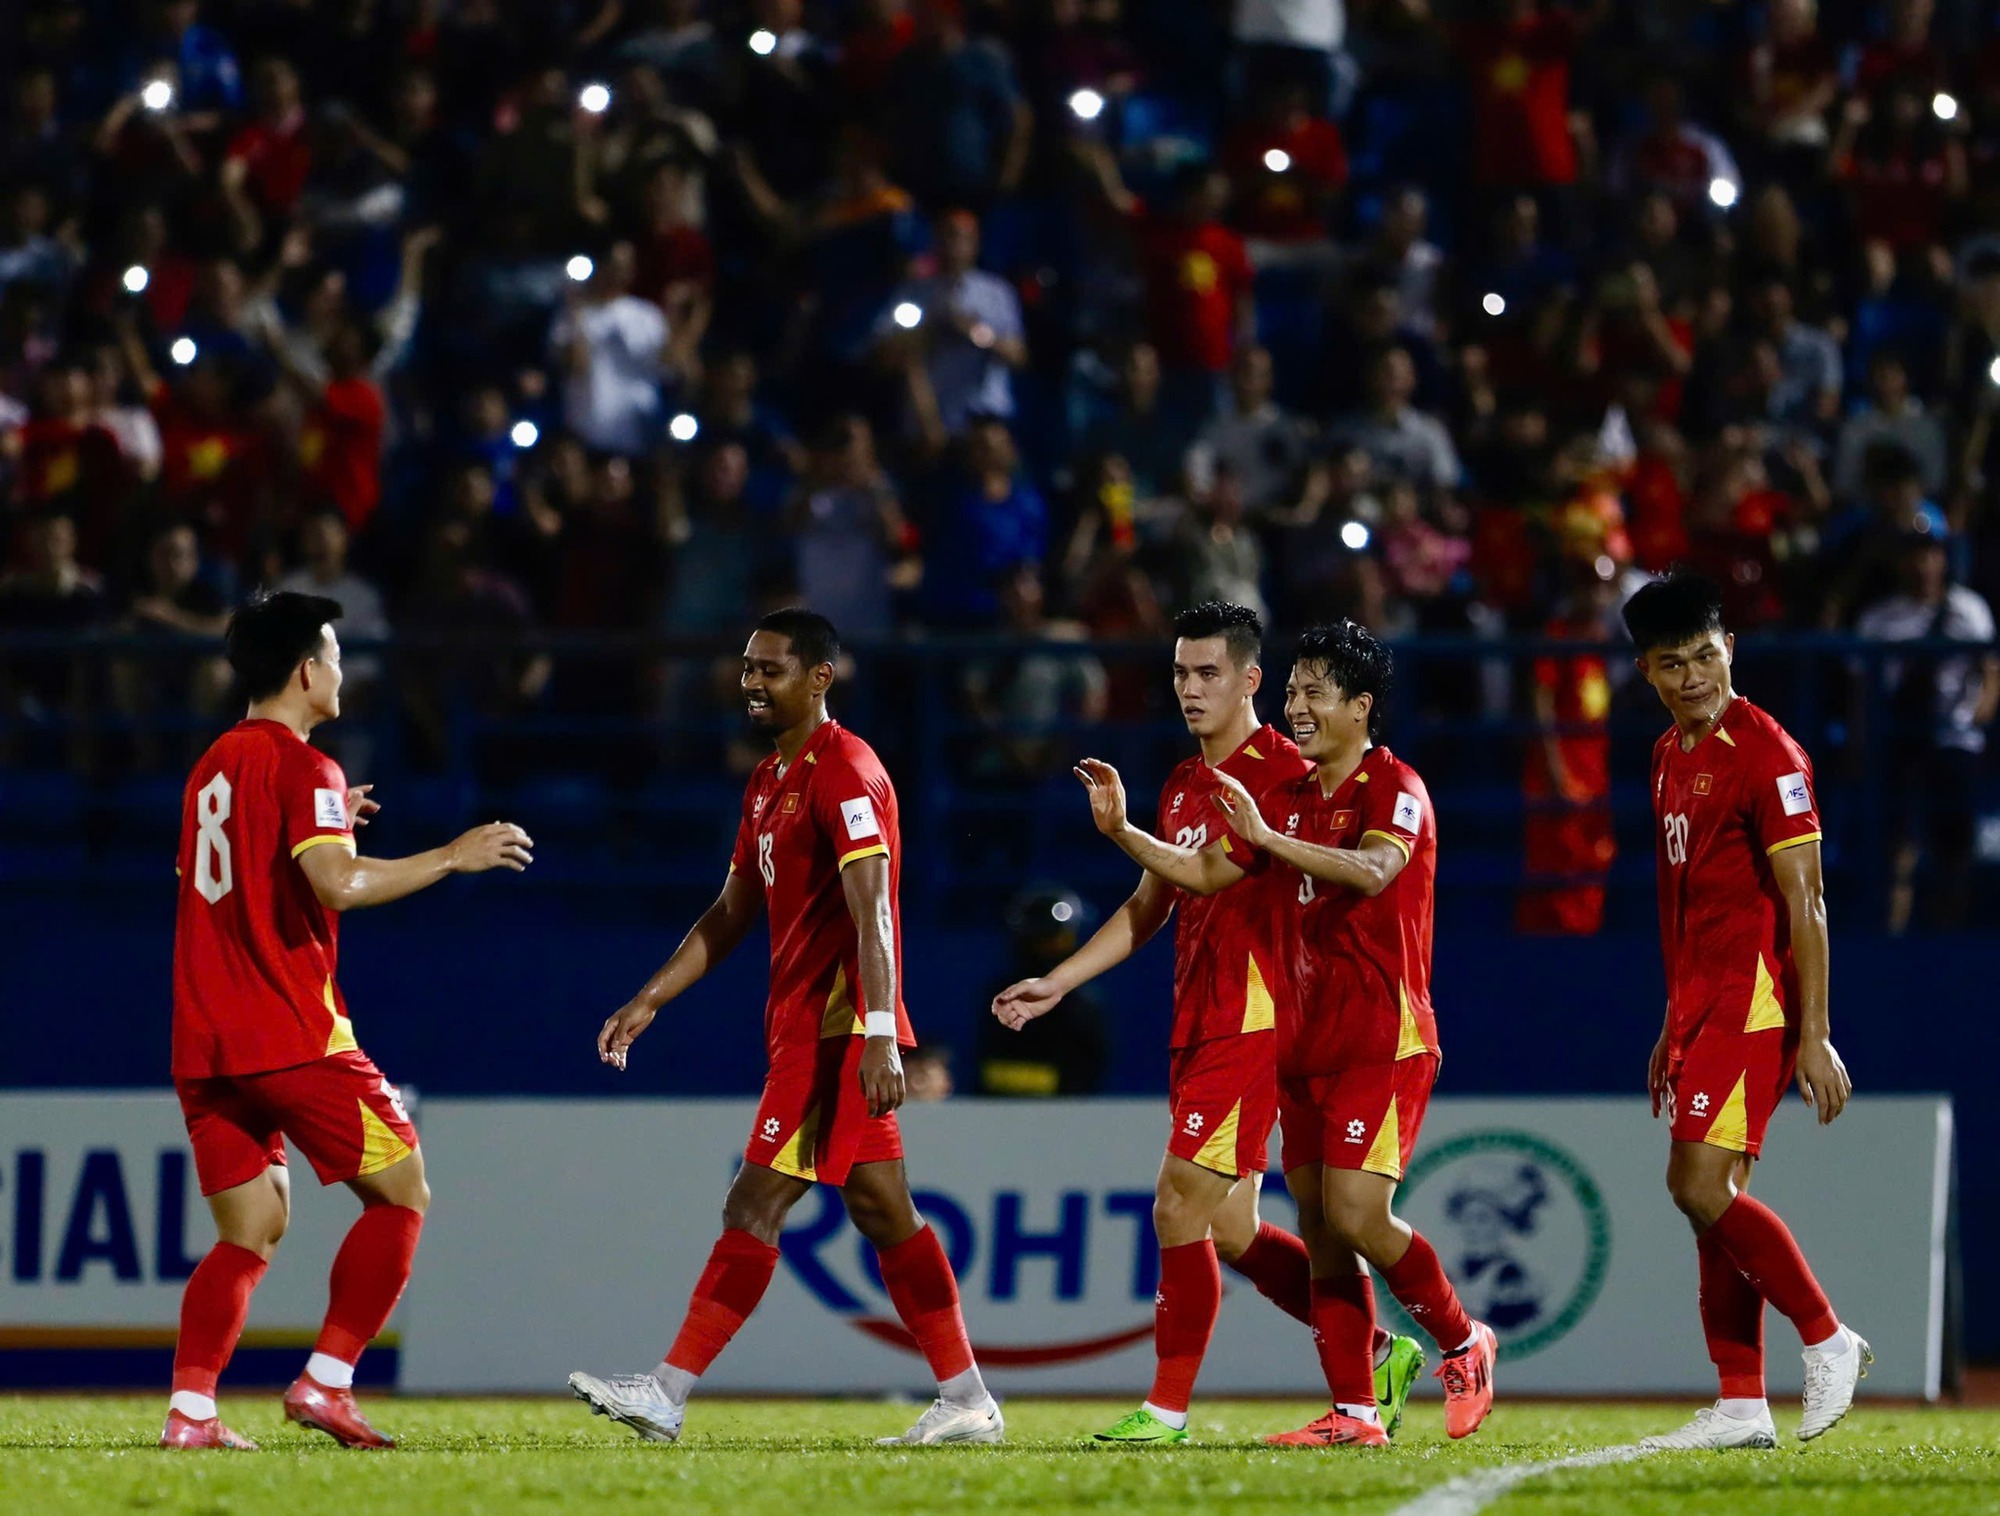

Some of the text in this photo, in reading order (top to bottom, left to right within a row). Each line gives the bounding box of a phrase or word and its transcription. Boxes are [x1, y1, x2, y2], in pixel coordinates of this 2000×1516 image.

[194, 771, 233, 905] 8
[758, 831, 775, 888] 13
[1664, 812, 1689, 866] 20
[0, 1149, 204, 1284] IAL
[734, 1155, 1302, 1314] ROHT
